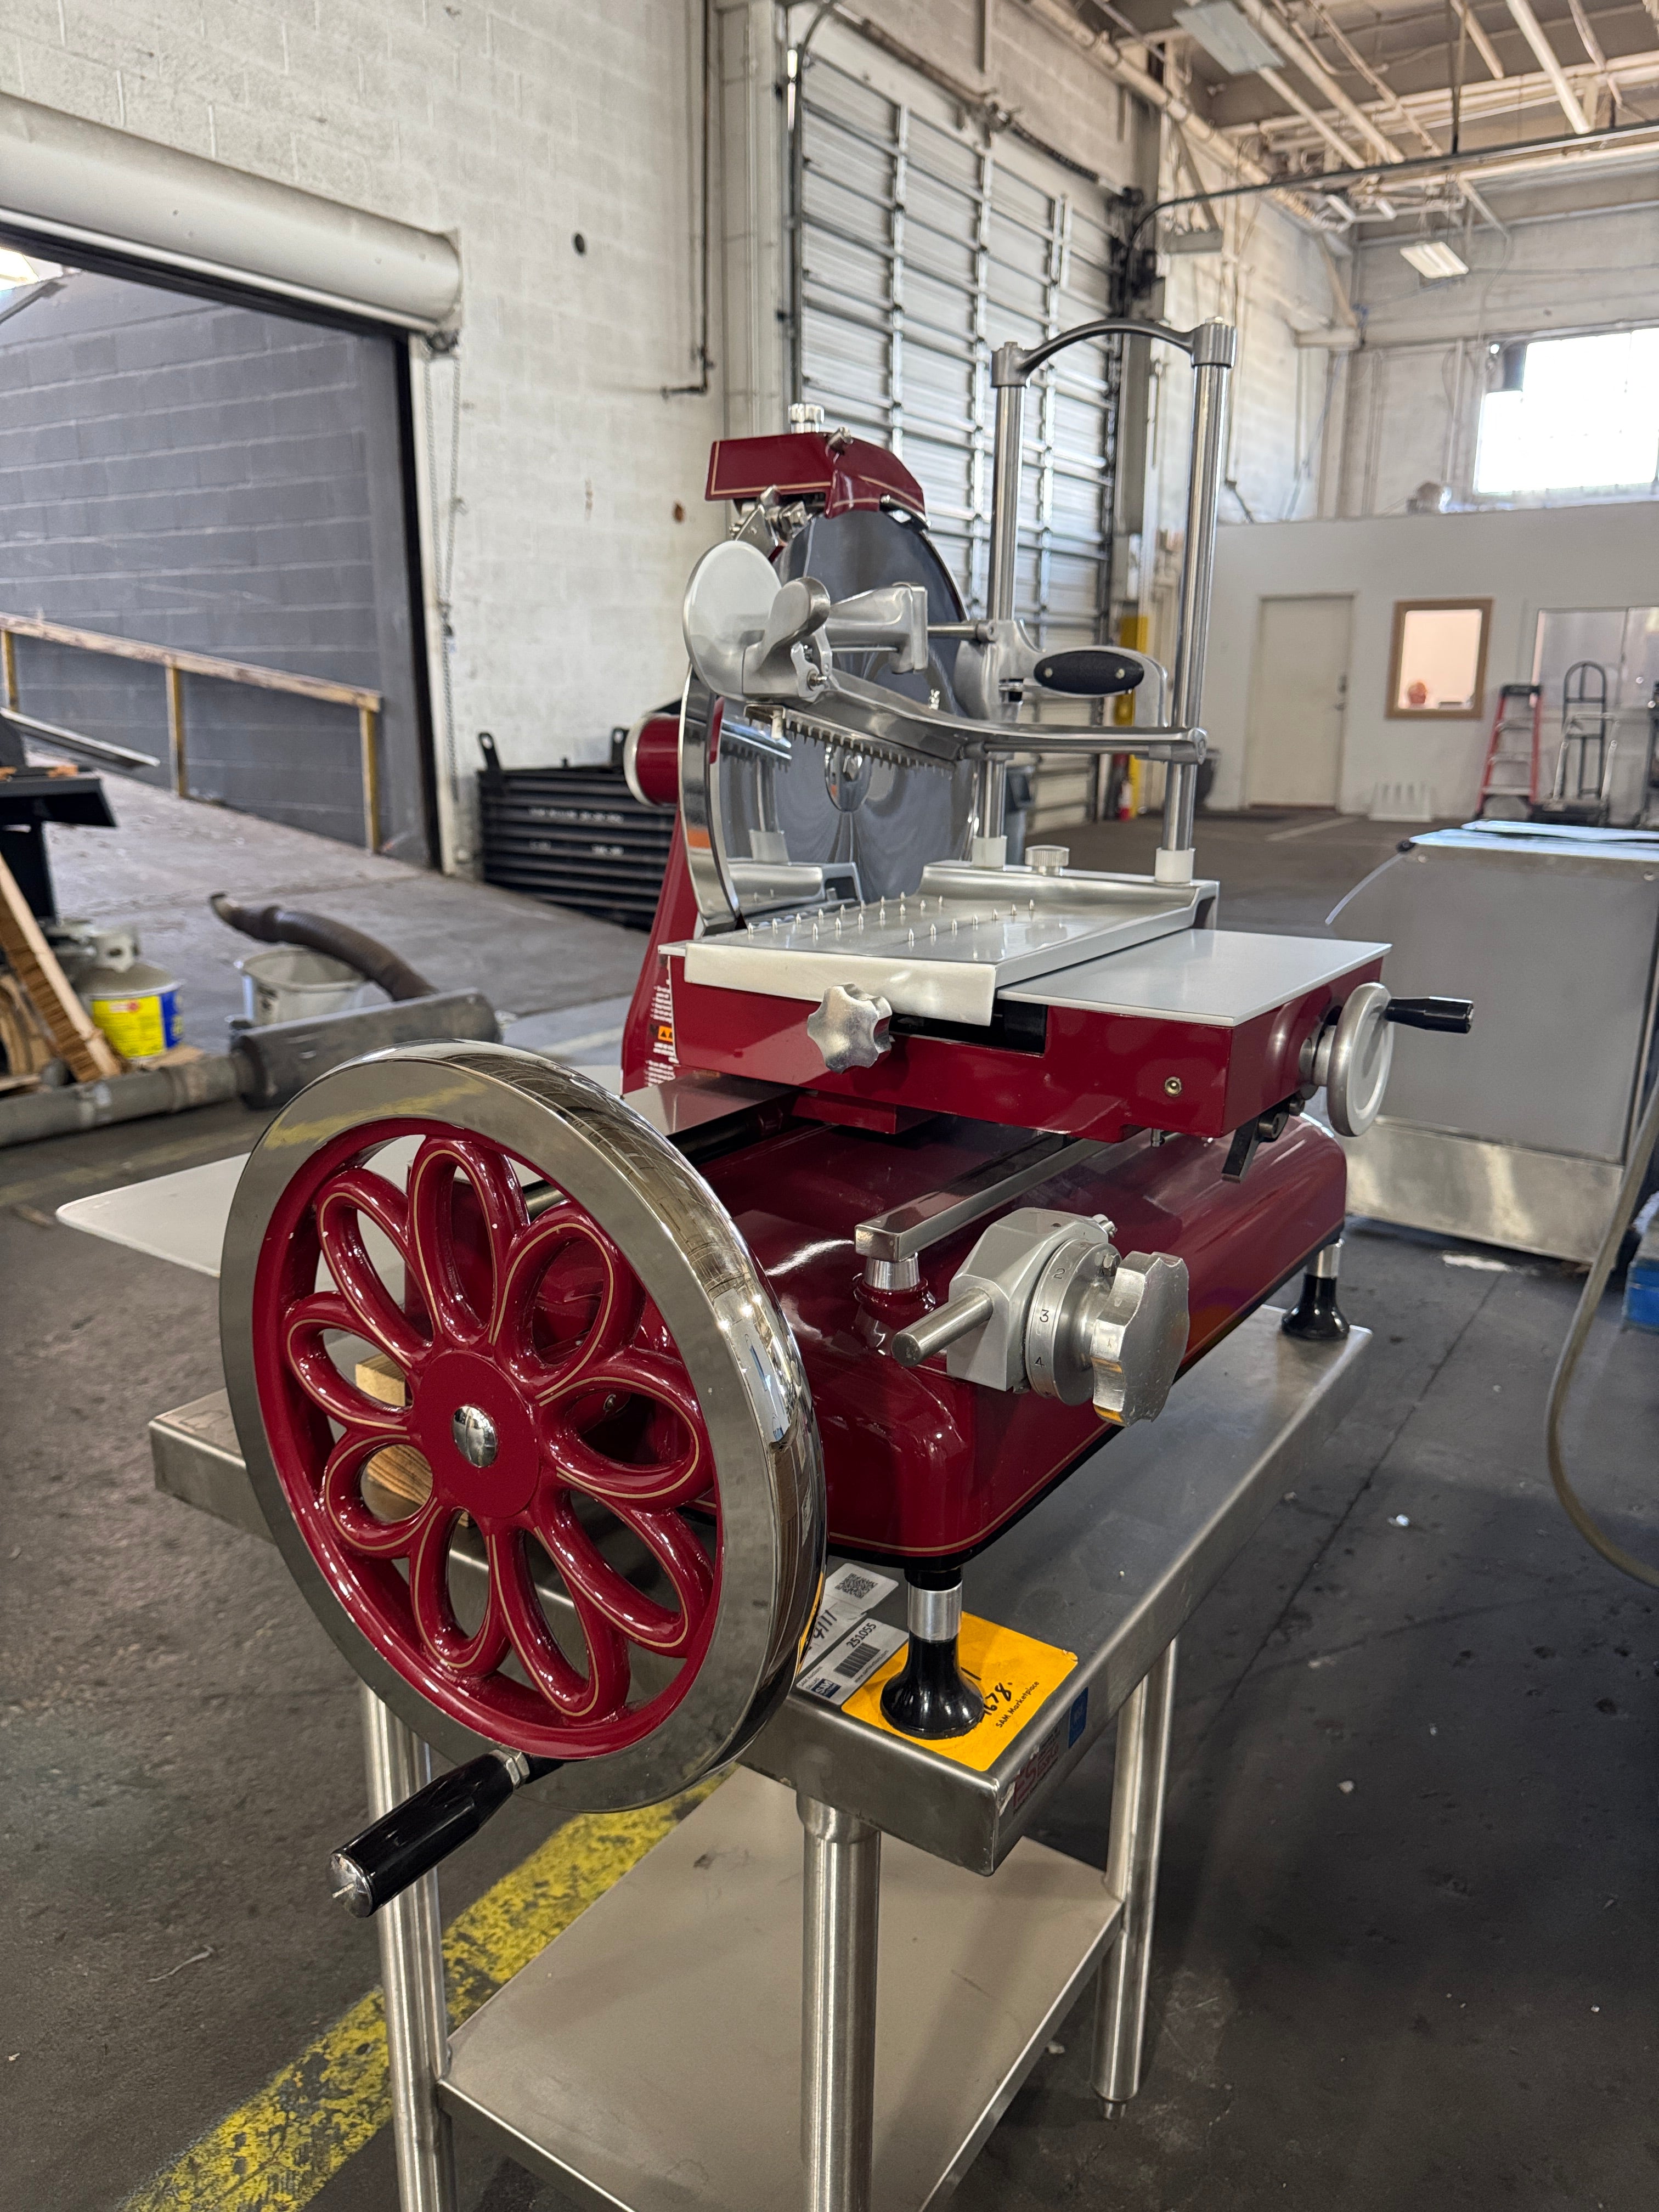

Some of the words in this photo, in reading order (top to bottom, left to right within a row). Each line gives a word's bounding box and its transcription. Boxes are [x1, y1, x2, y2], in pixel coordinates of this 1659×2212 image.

[1053, 1268, 1065, 1279] 2
[1040, 1309, 1049, 1323] 3
[1035, 1356, 1045, 1369] 4
[846, 1622, 877, 1648] 251055
[815, 1680, 832, 1694] SAM
[995, 1714, 1011, 1728] SAM
[1007, 1681, 1040, 1715] Marketplace
